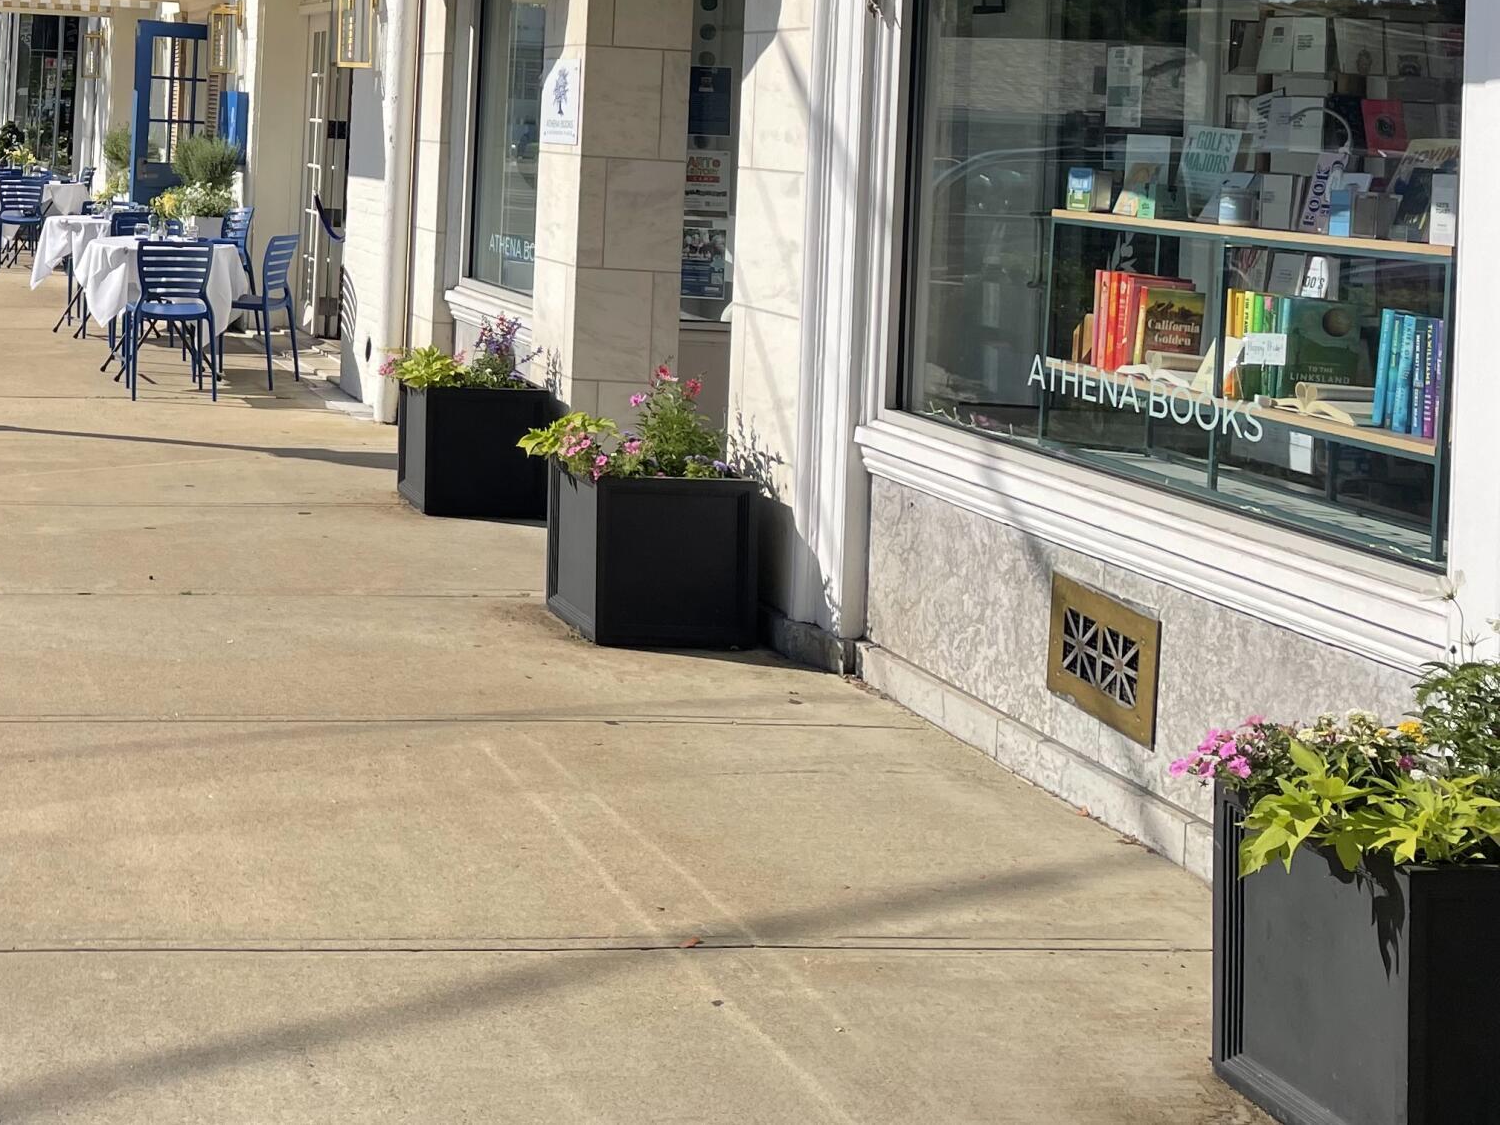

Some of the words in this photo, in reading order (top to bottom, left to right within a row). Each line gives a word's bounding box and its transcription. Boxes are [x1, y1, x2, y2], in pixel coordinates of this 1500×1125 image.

[1196, 130, 1236, 153] GOLF'S
[1184, 151, 1230, 174] MAJORS
[489, 233, 523, 259] ATHENA
[1147, 318, 1200, 333] California
[1154, 332, 1192, 346] Golden
[1289, 372, 1351, 385] LINKSLAND
[1027, 354, 1140, 413] ATHENA
[1149, 382, 1263, 442] BOOKS
